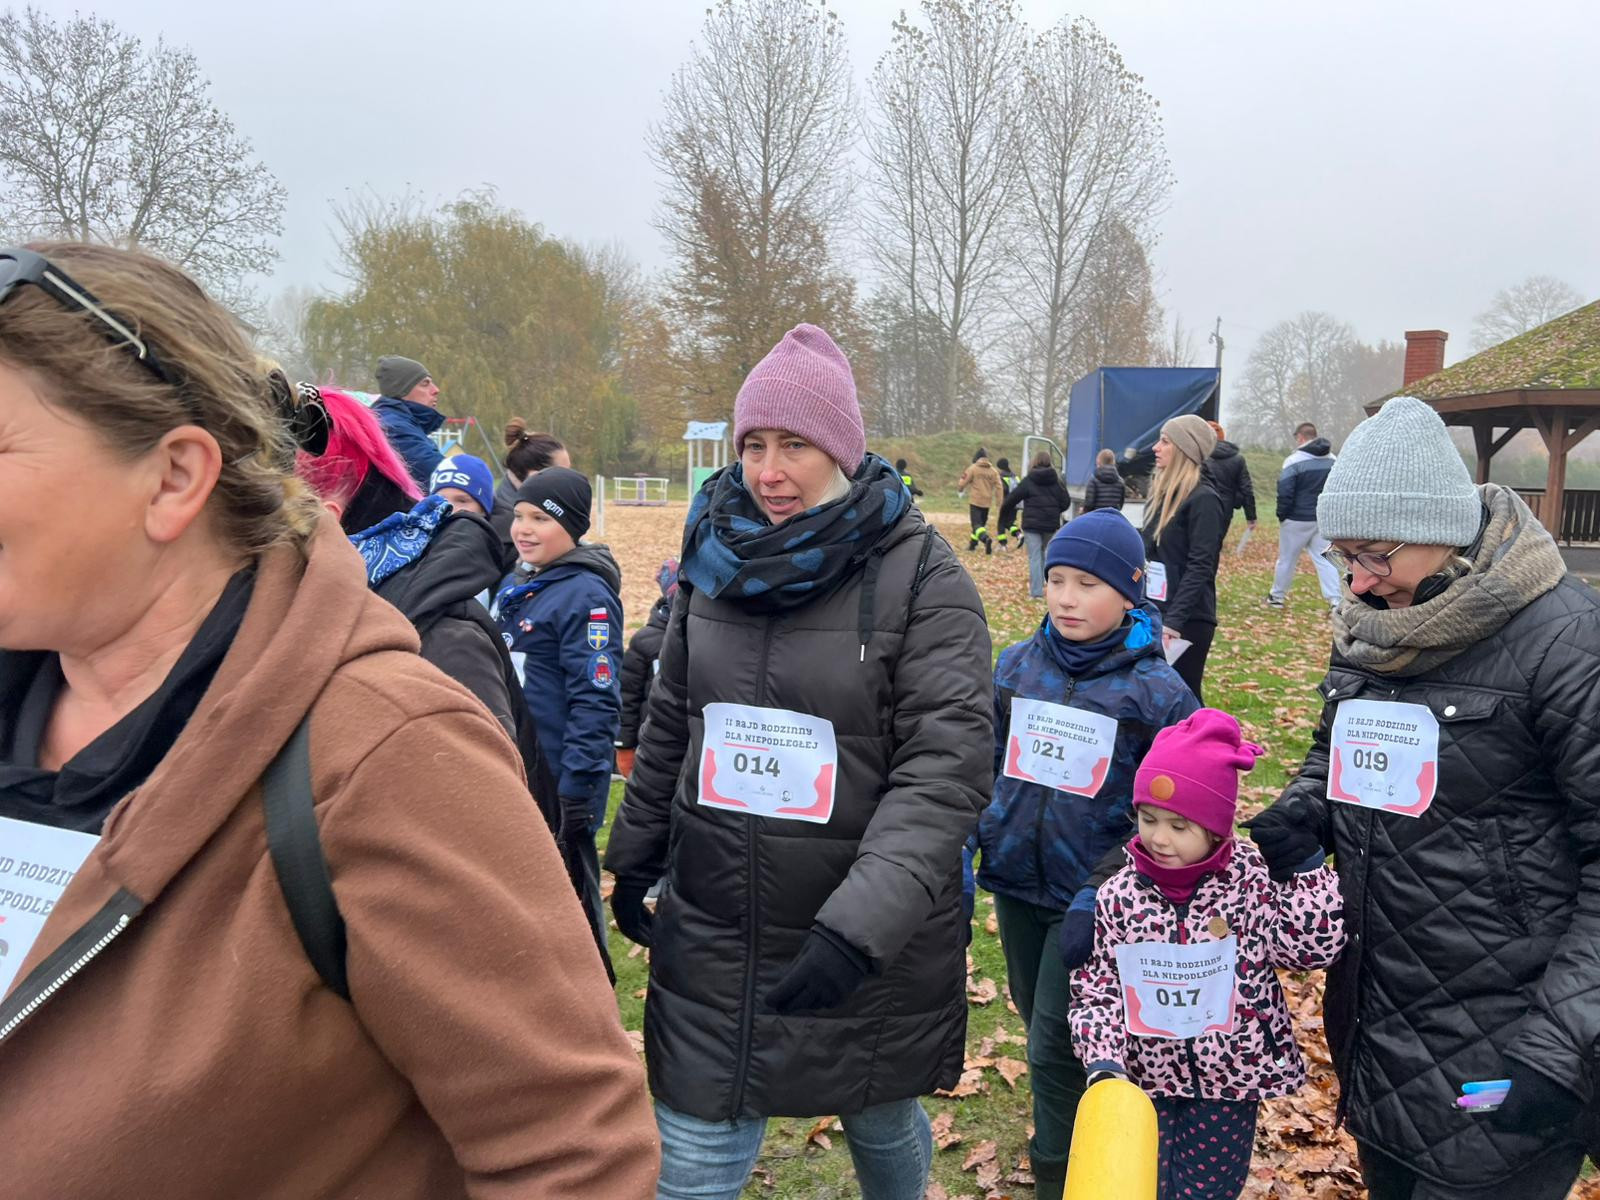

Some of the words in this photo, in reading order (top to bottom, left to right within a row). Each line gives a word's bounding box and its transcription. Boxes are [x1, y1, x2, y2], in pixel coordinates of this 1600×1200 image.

[725, 731, 742, 741] DLA
[745, 734, 819, 750] NIEPODLEGŁEJ
[1347, 729, 1361, 738] DLA
[1032, 739, 1065, 761] 021
[733, 753, 780, 778] 014
[1353, 748, 1388, 772] 019
[1142, 969, 1159, 978] DLA
[1156, 988, 1201, 1007] 017
